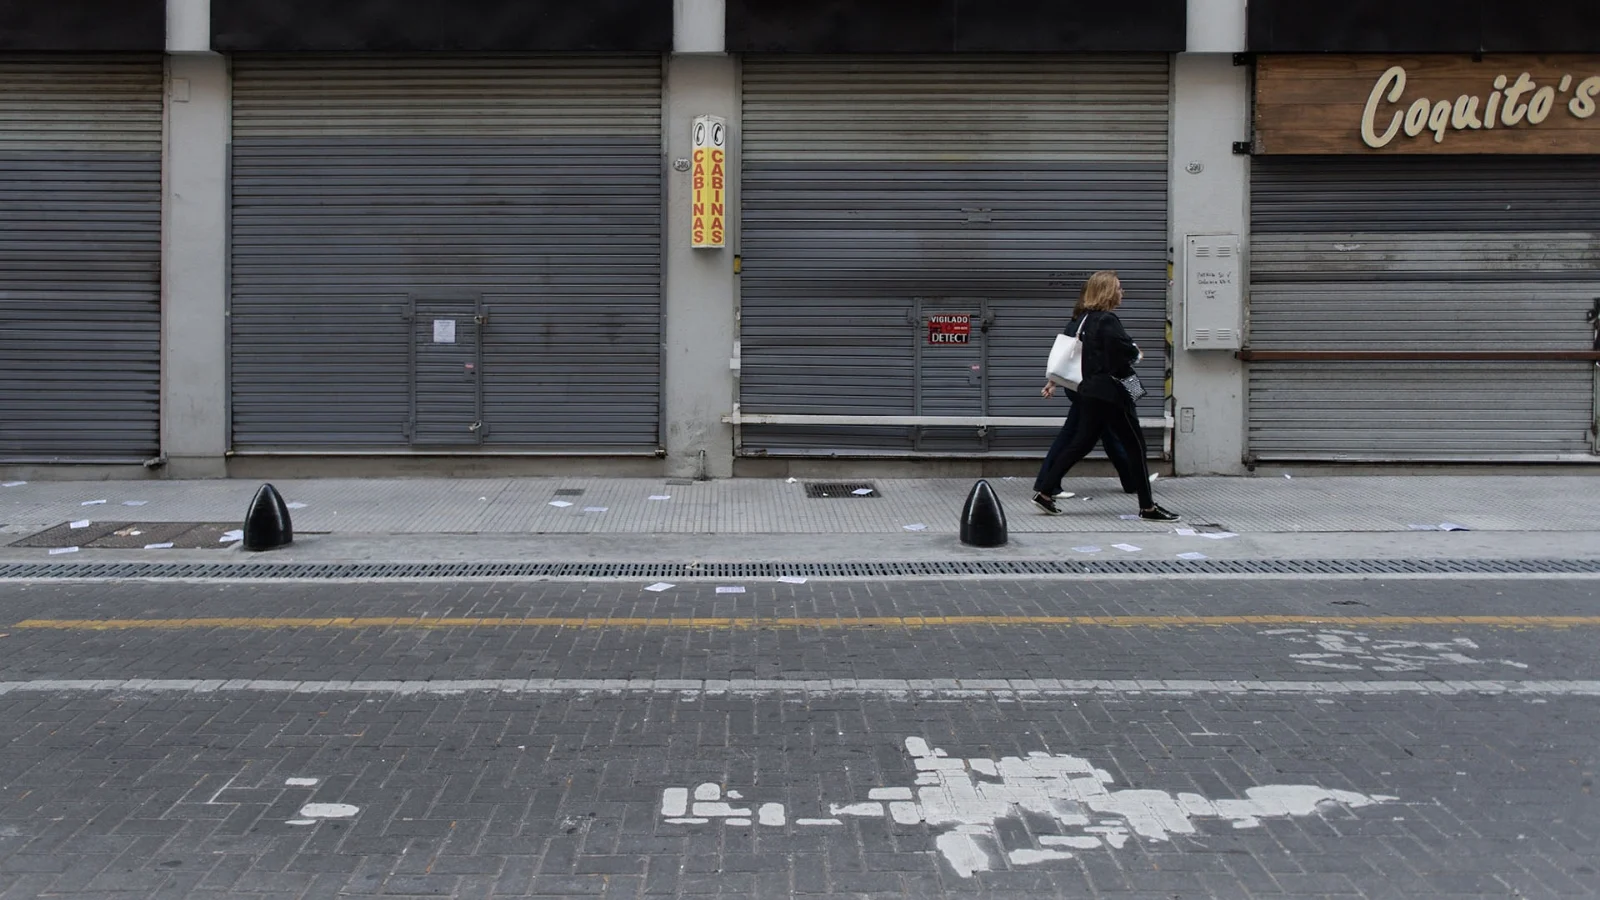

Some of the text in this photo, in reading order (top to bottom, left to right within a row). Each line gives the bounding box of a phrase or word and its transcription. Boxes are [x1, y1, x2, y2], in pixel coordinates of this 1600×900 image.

[1361, 66, 1600, 149] Coquito's
[693, 150, 704, 243] CABINAS
[711, 150, 723, 243] CABINAS
[931, 333, 967, 343] DETECT
